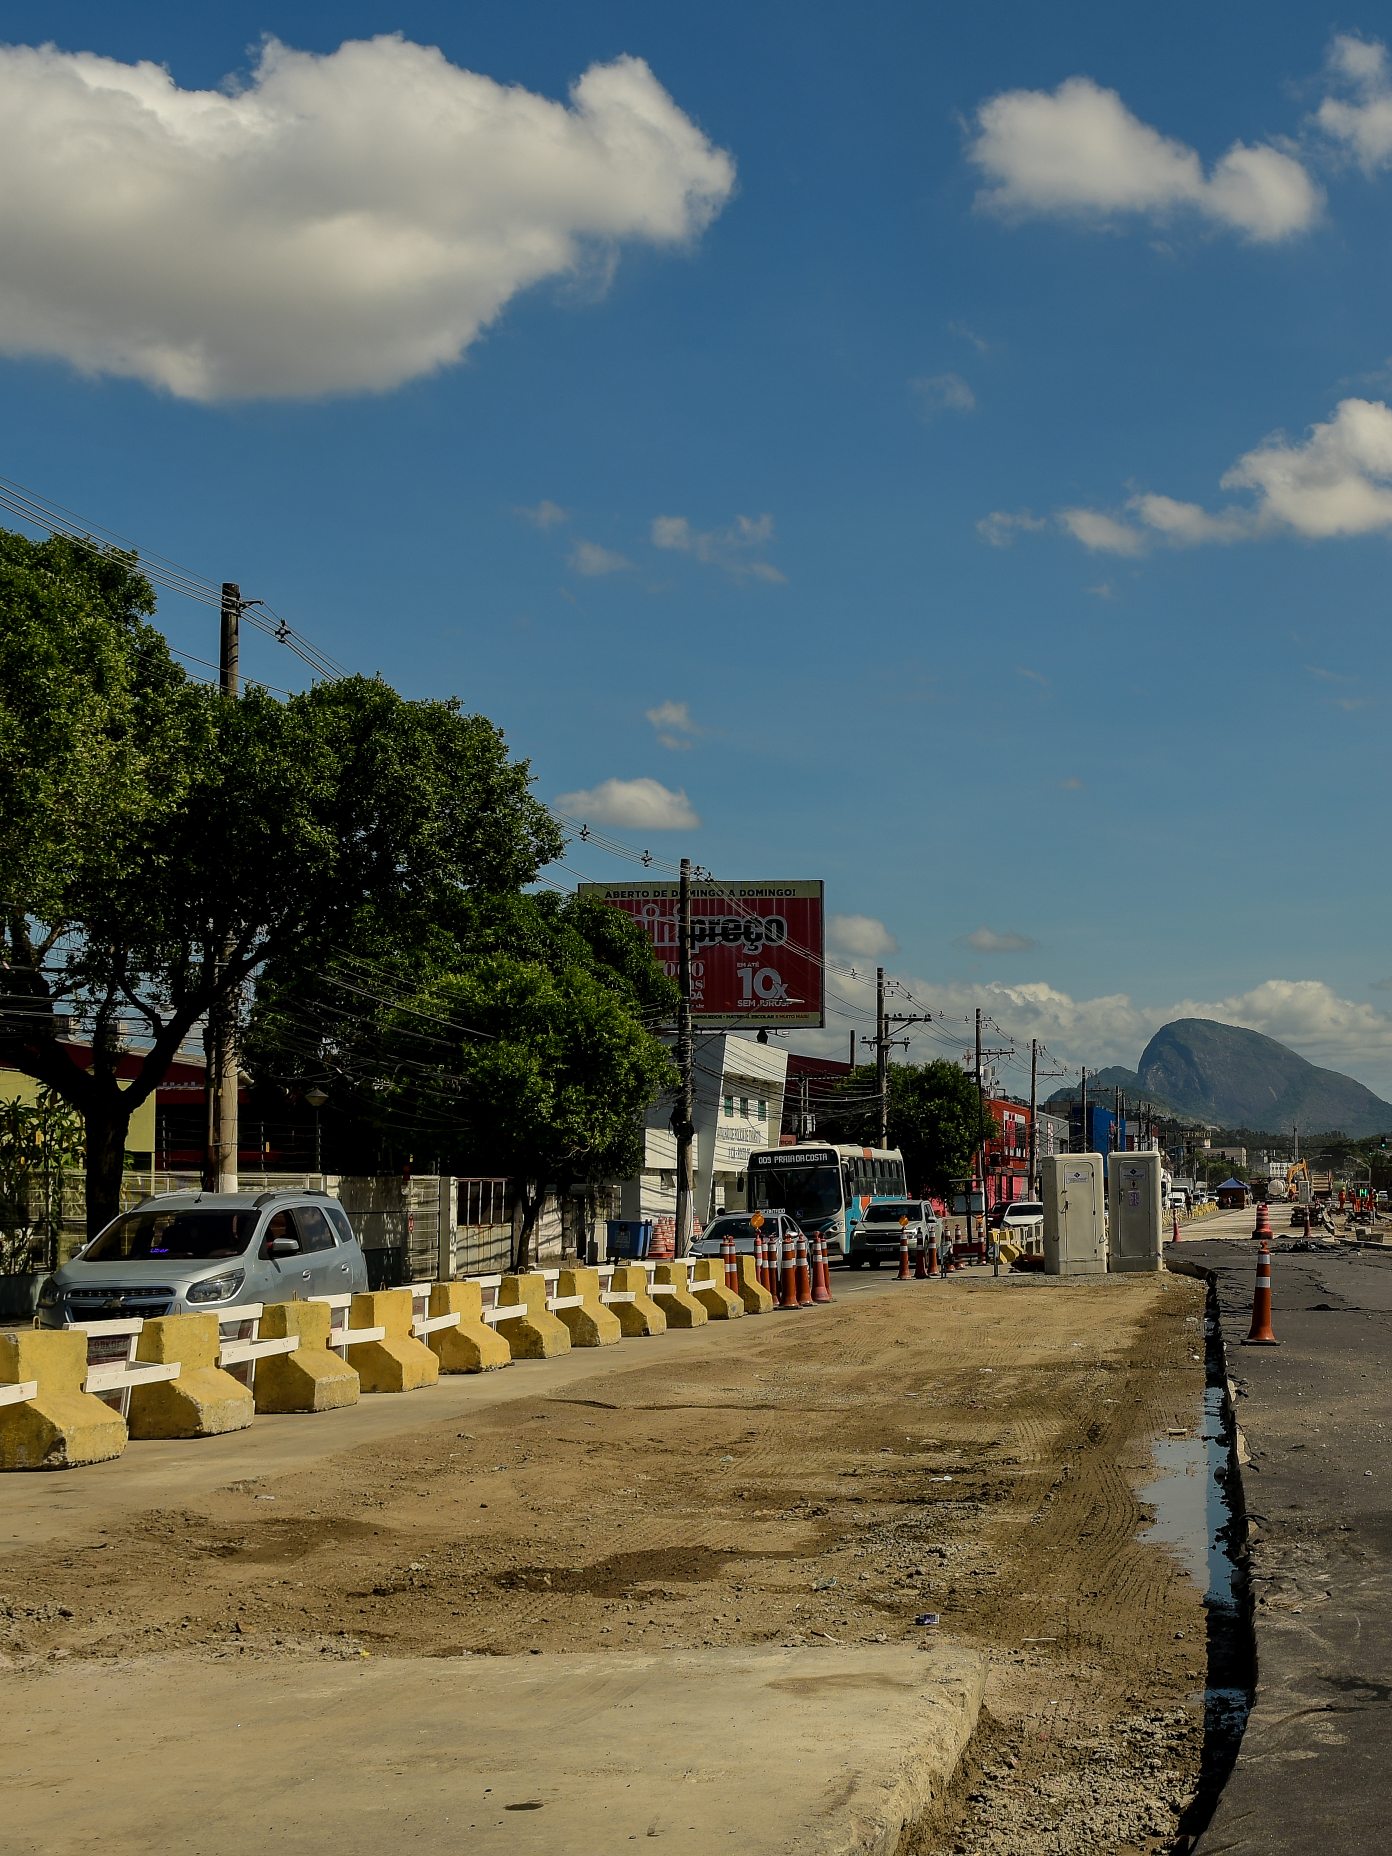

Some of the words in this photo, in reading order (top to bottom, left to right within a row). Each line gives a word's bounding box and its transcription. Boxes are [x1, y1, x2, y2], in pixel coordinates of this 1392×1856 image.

[605, 889, 650, 899] ABERTO
[653, 889, 668, 898] DE
[671, 889, 724, 898] DMINGO
[727, 889, 736, 898] A
[739, 888, 797, 898] DOMINGO!
[736, 967, 789, 999] 10x
[737, 999, 756, 1007] SEM
[774, 1155, 795, 1164] PRAIA
[805, 1153, 828, 1162] COSTA
